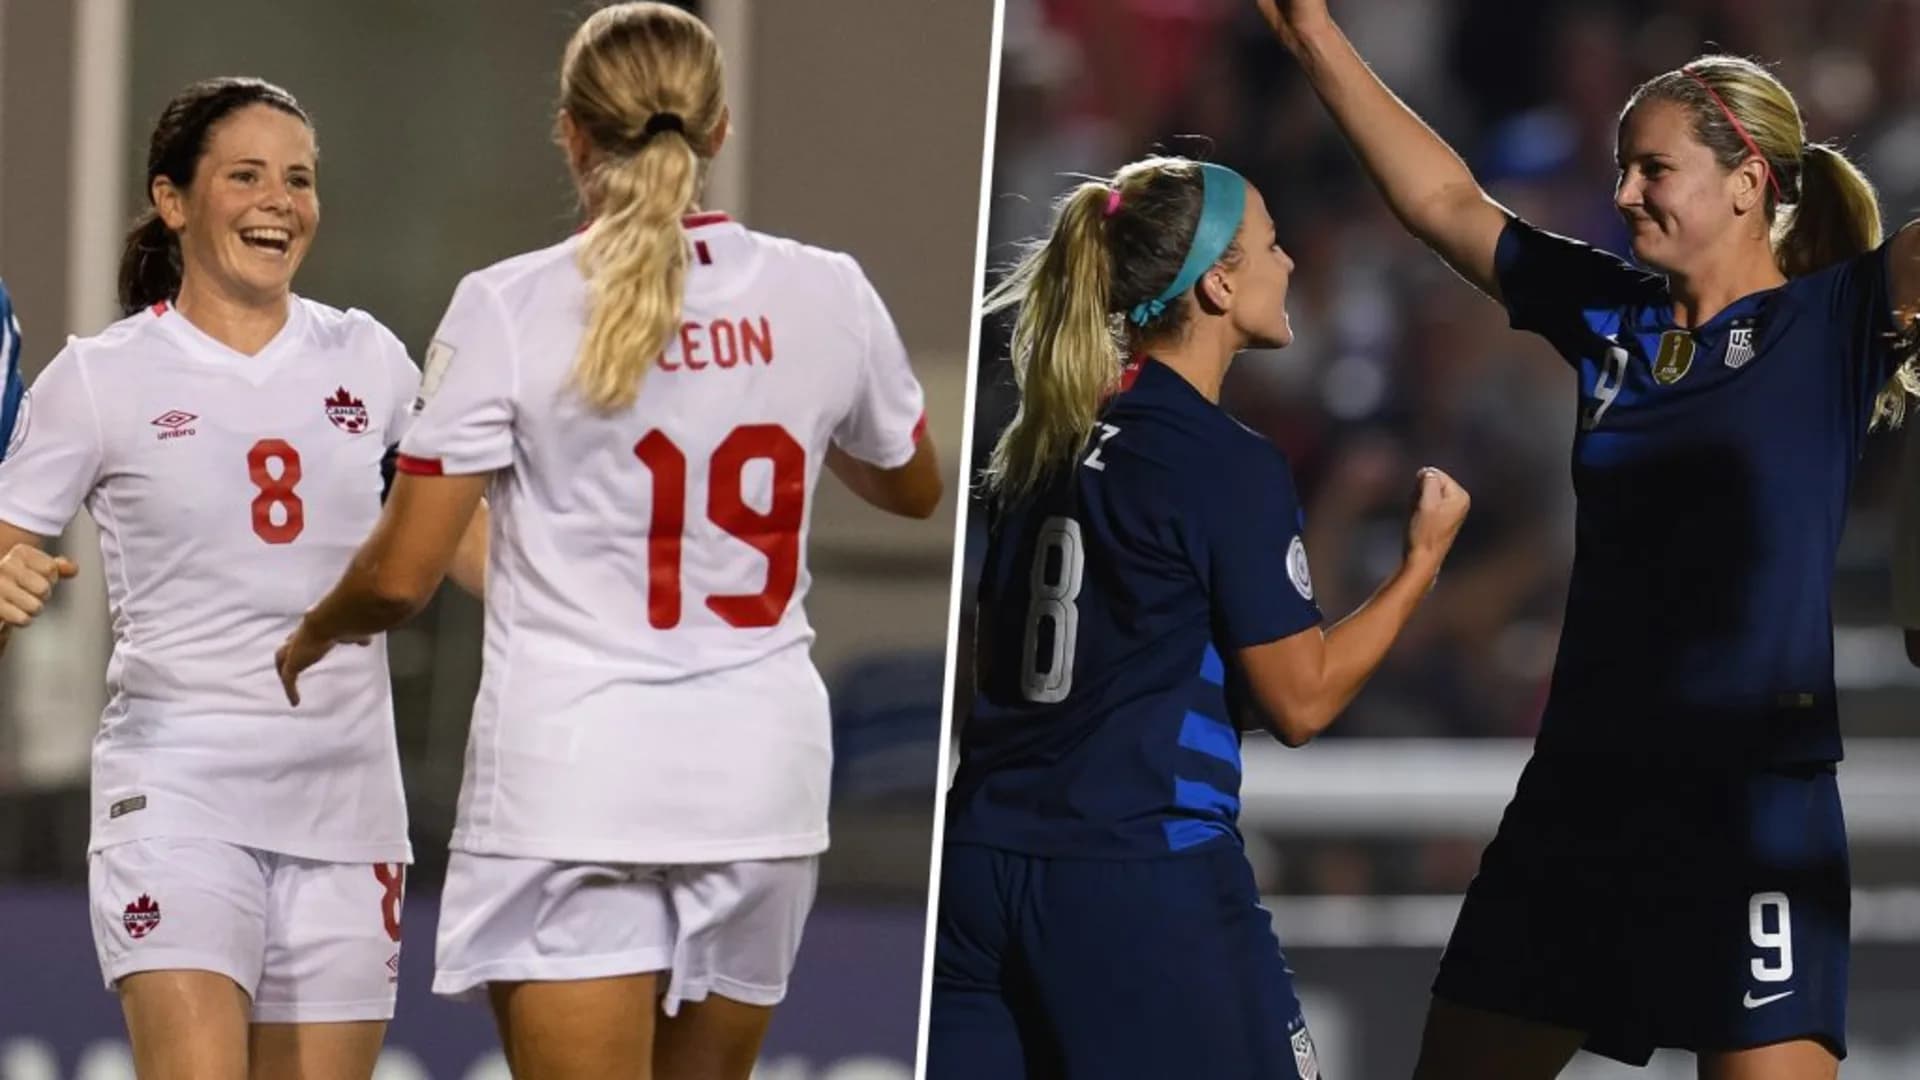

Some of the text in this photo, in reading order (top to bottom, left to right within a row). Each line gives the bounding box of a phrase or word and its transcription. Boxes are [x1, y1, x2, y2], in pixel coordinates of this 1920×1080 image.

[156, 428, 196, 440] umbro
[1581, 345, 1629, 431] 9
[246, 438, 305, 544] 8
[633, 423, 806, 630] 19
[1021, 516, 1085, 703] 8
[1749, 891, 1794, 982] 9
